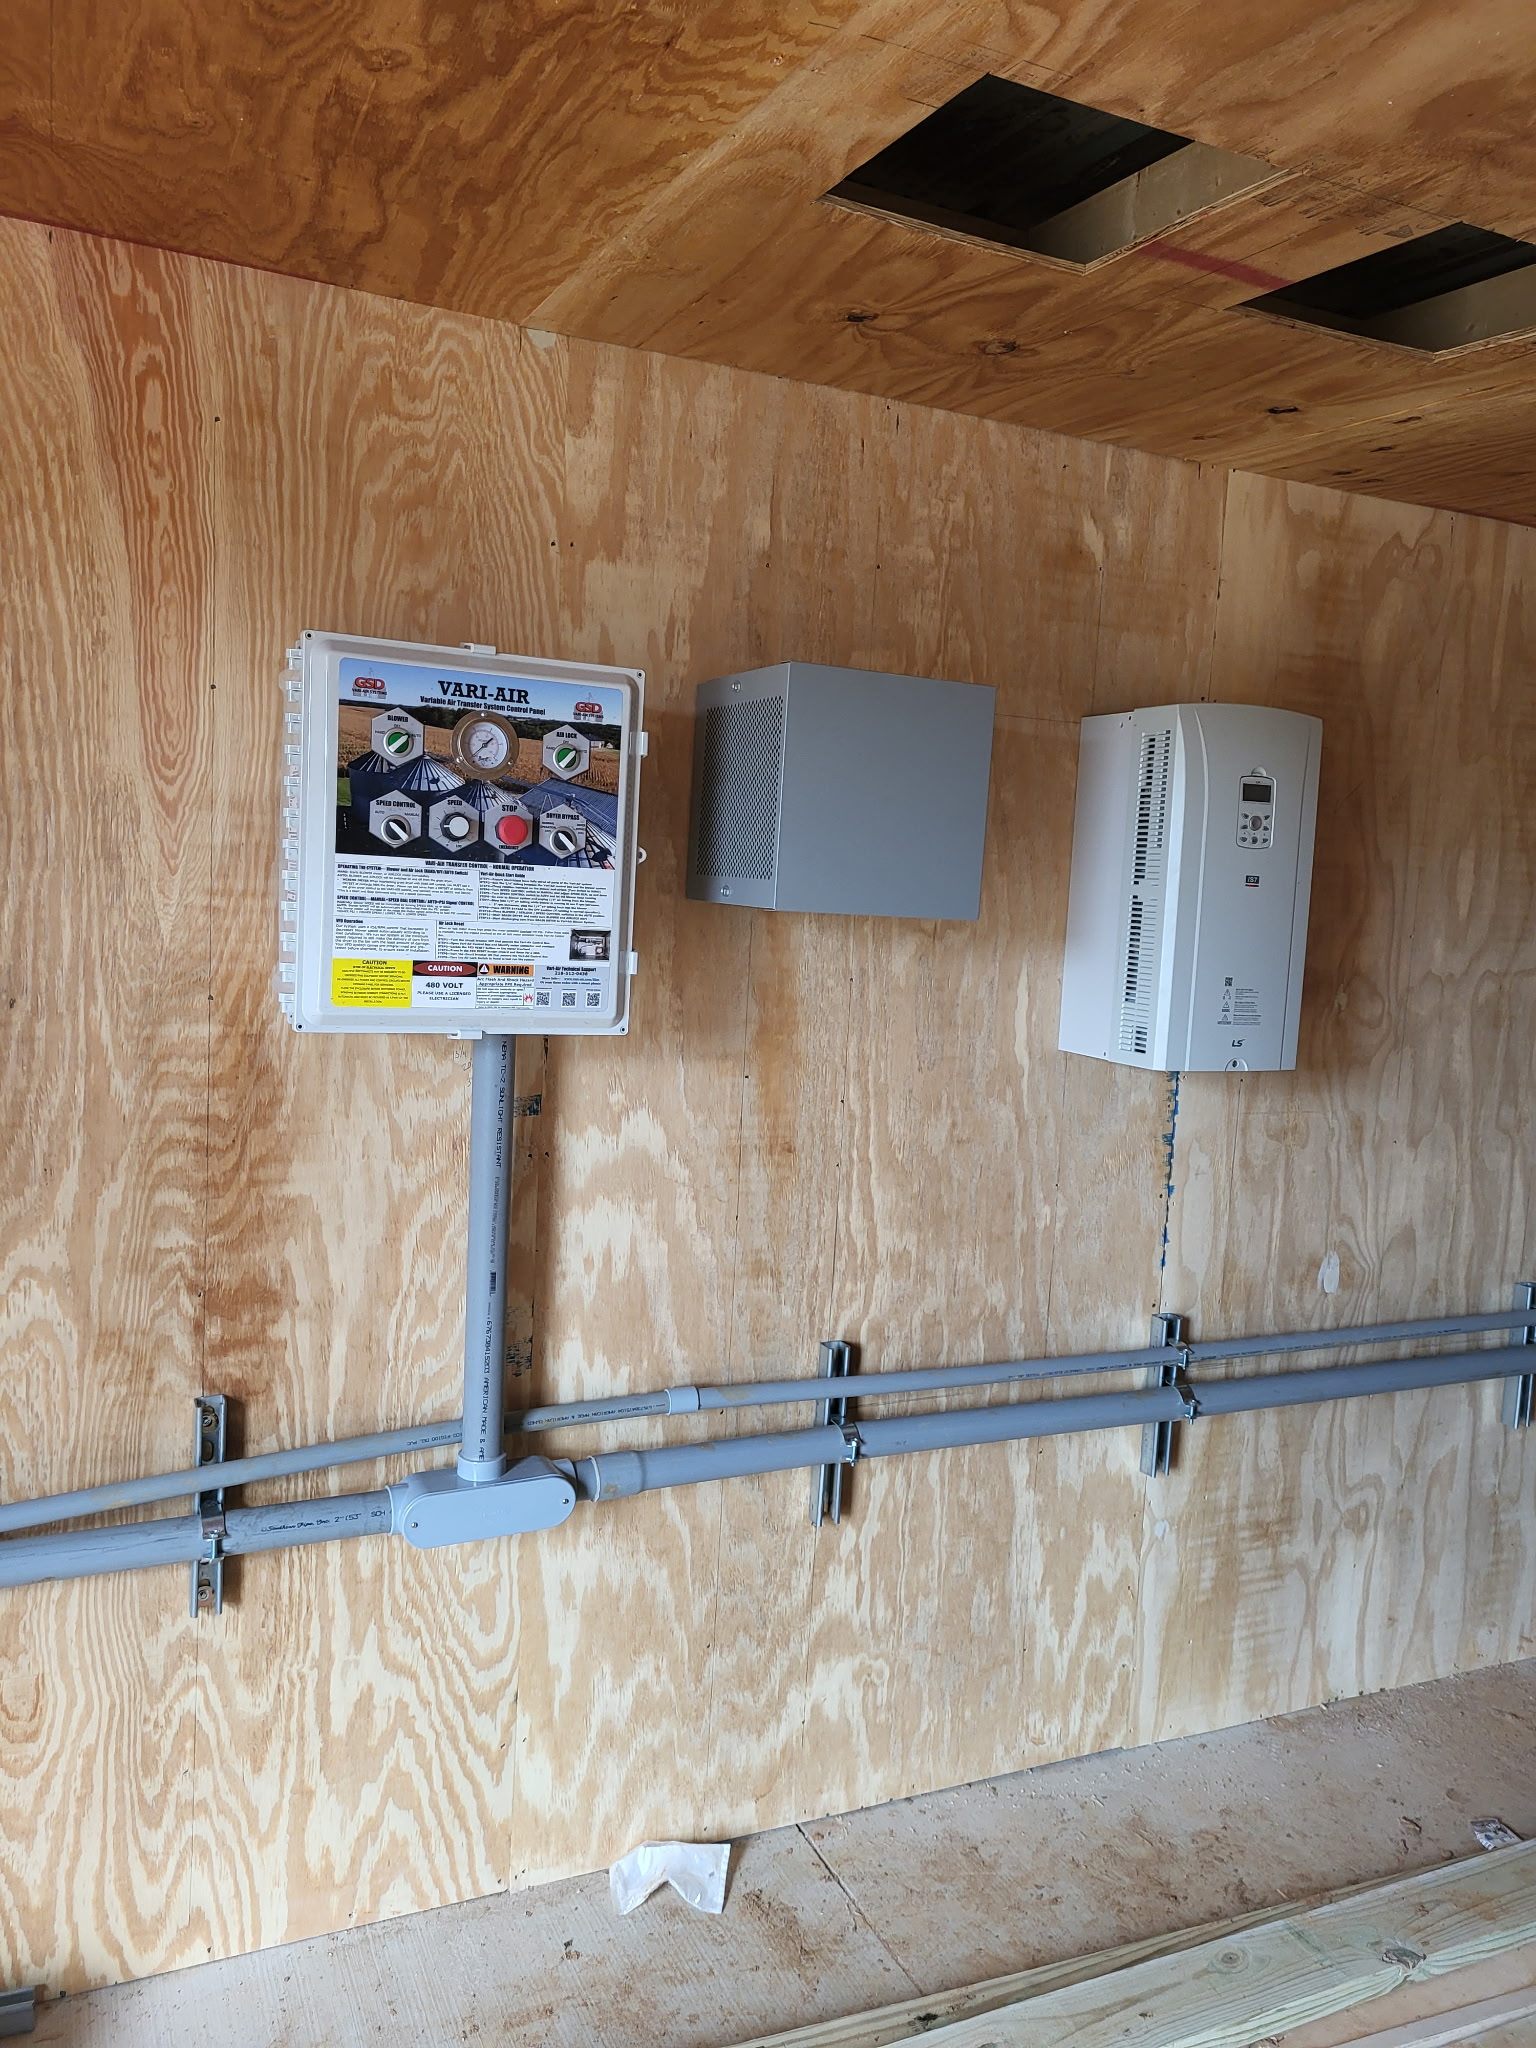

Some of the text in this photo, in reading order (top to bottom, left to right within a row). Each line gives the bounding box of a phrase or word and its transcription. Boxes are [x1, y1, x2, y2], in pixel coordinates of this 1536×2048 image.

[354, 676, 386, 690] GSD
[437, 680, 530, 705] VARI-AIR
[420, 696, 546, 716] Variable Air Transfer System Control Panel
[575, 702, 603, 714] GSD
[562, 813, 580, 821] BYPASS
[427, 965, 463, 973] CAUTION
[493, 965, 530, 975] WARNING
[1231, 1038, 1247, 1048] LS
[497, 1086, 506, 1123] SUNLIGHT
[495, 1127, 503, 1168] RESISTANT
[482, 1377, 490, 1413] AMERICAN
[480, 1416, 488, 1435] MADE
